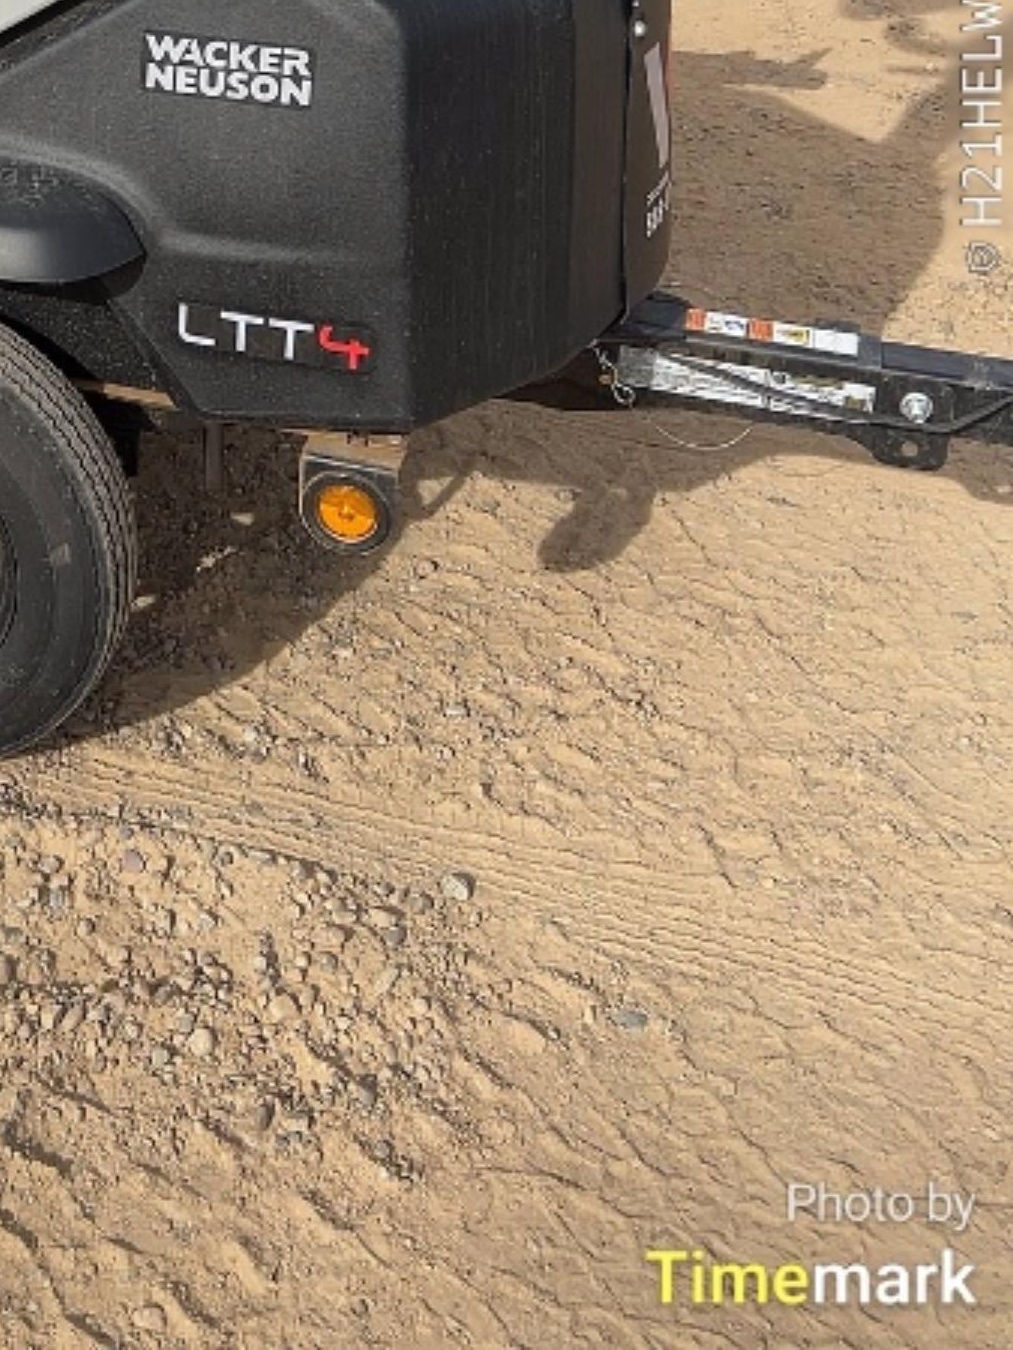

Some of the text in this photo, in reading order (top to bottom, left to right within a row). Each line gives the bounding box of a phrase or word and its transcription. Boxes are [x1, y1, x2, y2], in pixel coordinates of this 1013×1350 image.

[145, 32, 312, 78] WACKER
[145, 61, 313, 108] NEUSON
[178, 301, 370, 371] LTT4
